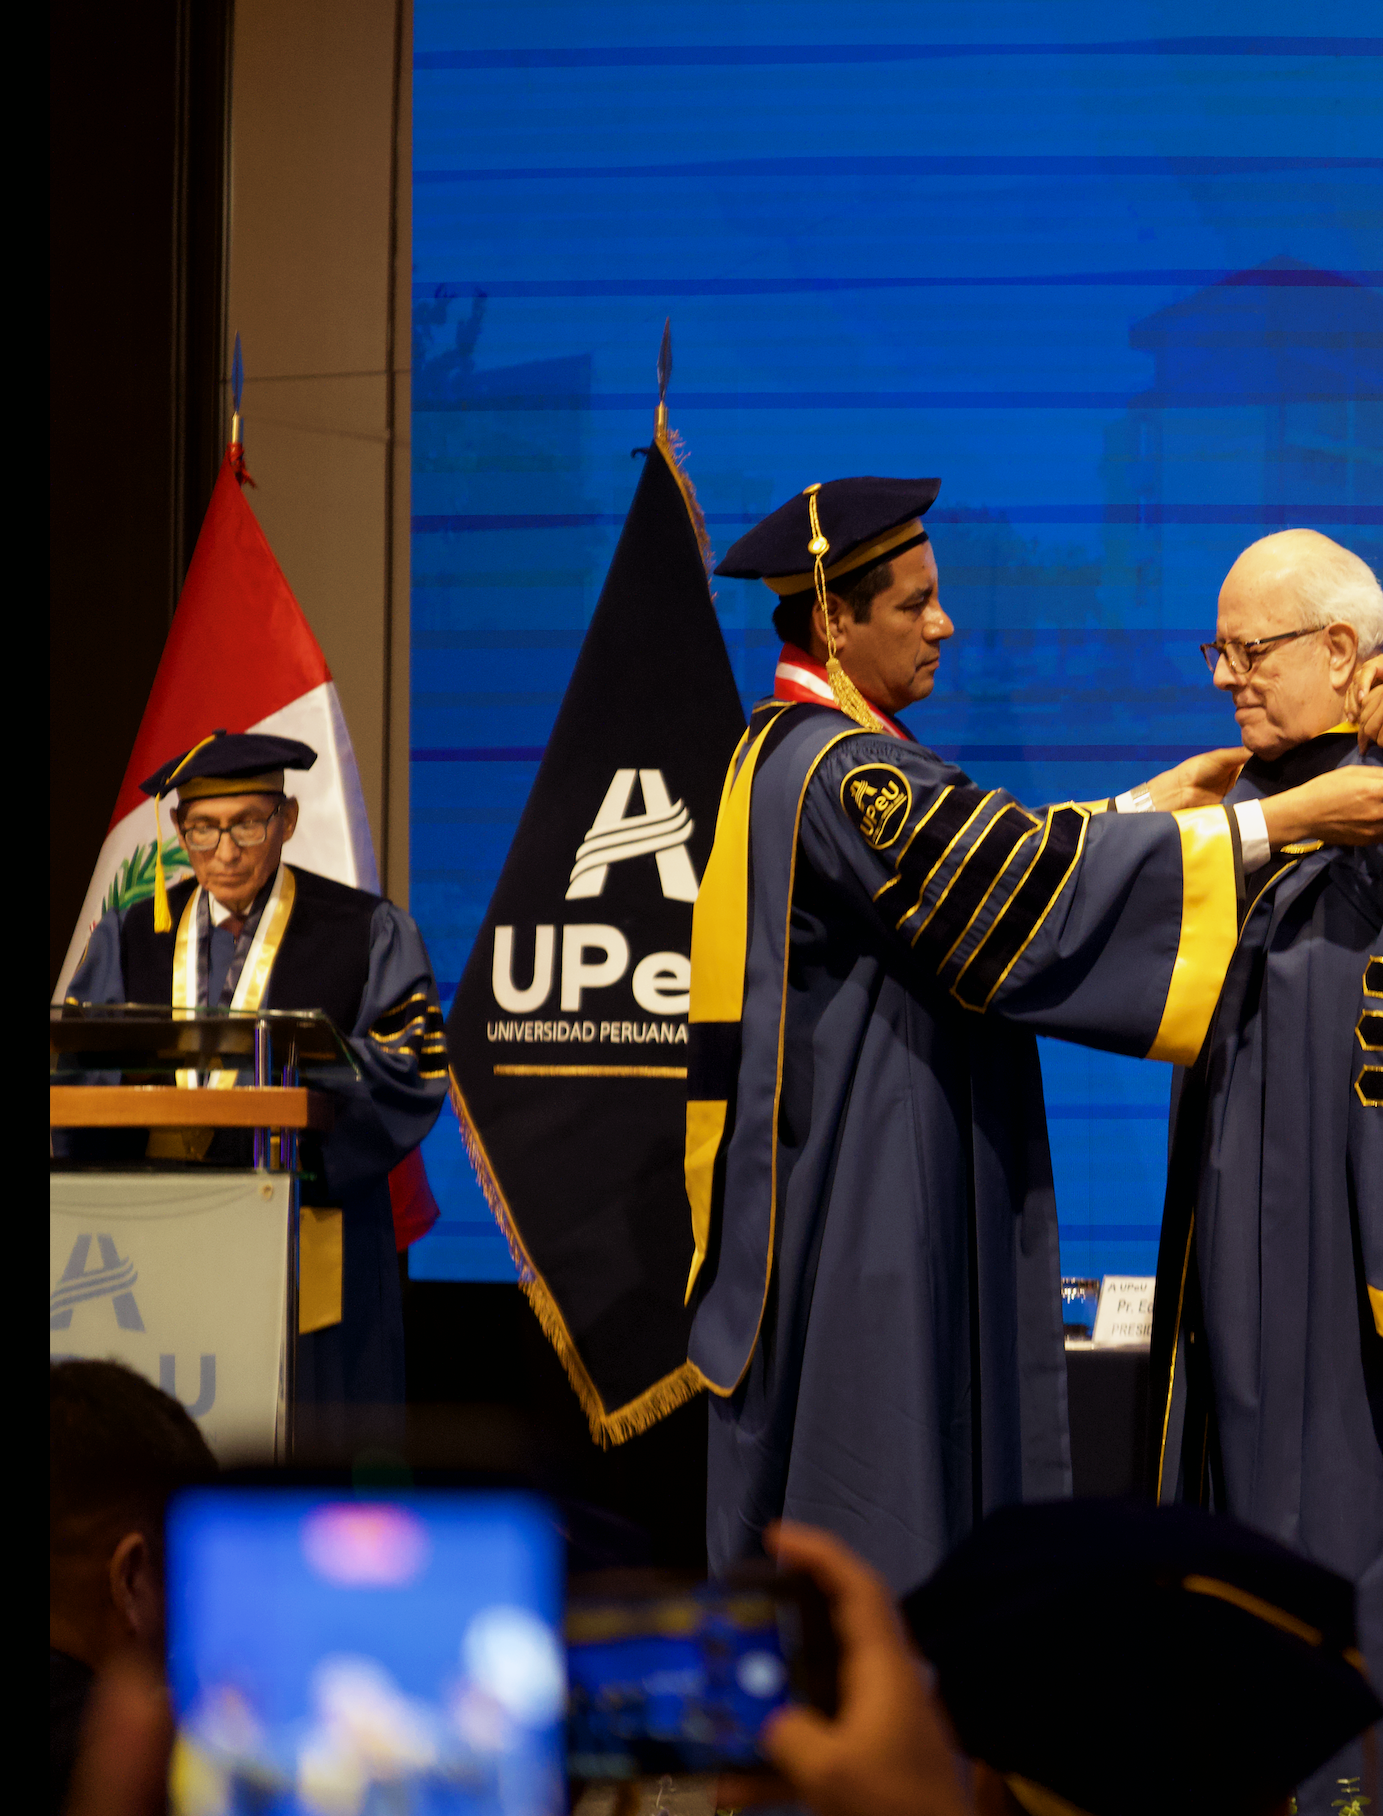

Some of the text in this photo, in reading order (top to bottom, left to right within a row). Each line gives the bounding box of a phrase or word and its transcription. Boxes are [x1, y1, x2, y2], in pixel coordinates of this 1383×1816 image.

[860, 780, 900, 836] UPeU
[486, 1020, 689, 1045] UNIVERSIDAD PERUANA
